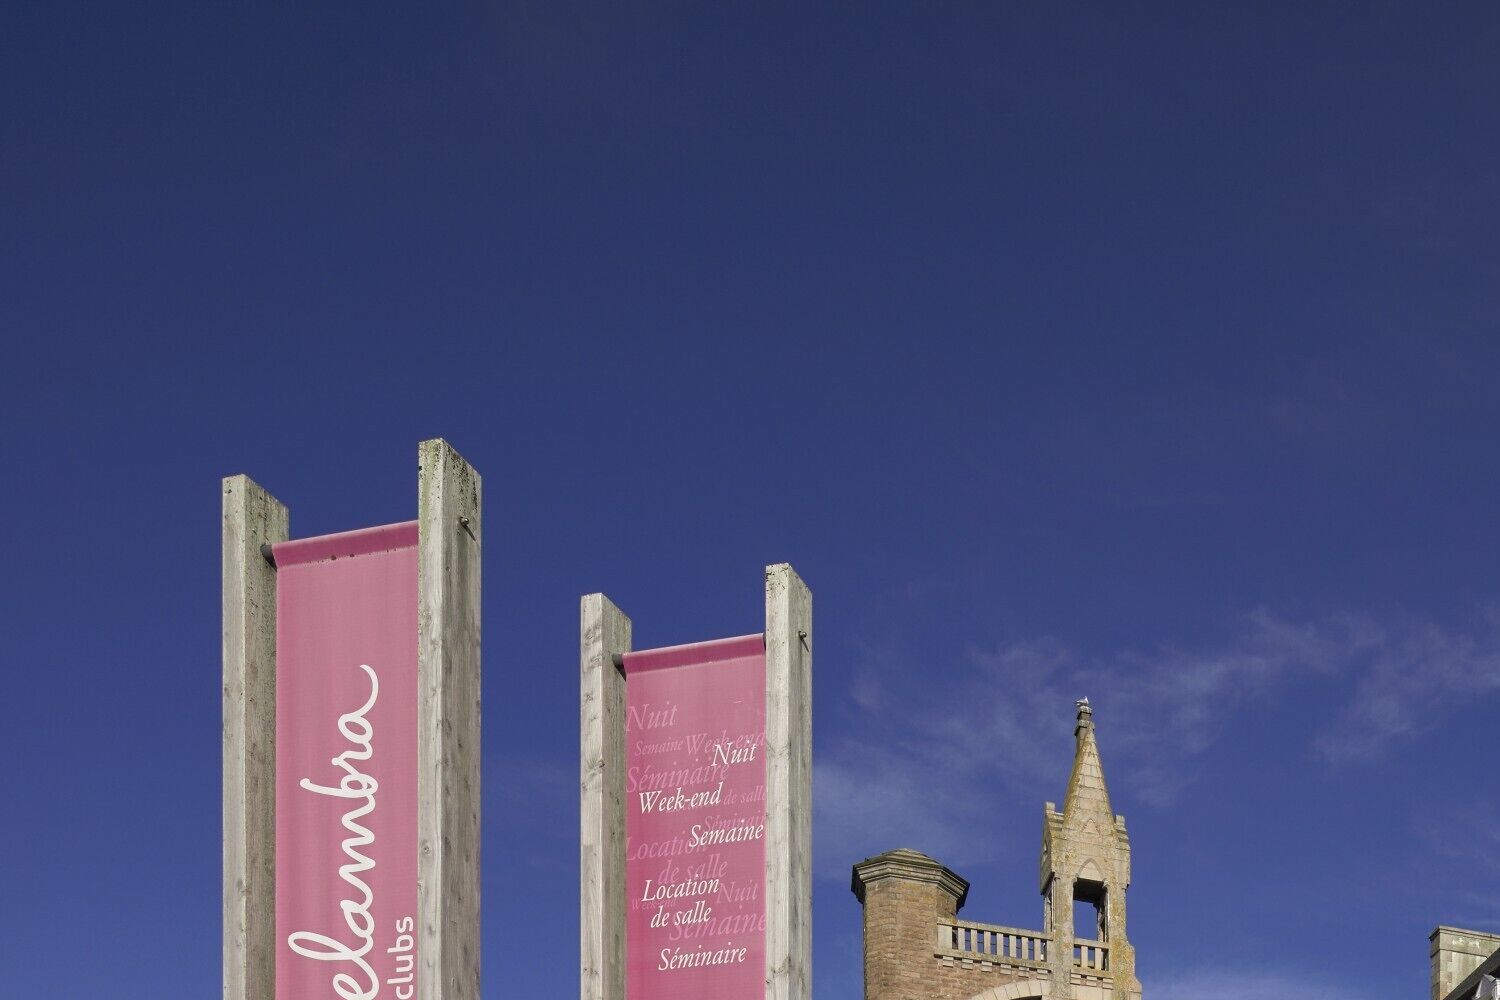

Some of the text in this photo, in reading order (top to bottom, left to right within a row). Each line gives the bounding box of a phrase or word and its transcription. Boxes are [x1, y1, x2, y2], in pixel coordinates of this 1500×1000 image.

[626, 701, 677, 732] Nuit
[711, 740, 757, 767] Nuit
[639, 781, 724, 815] Week-end
[689, 818, 764, 848] Semaine
[641, 873, 720, 902] Location
[717, 880, 758, 904] Nuit
[650, 900, 712, 929] de salle
[386, 916, 414, 1000] clubs
[658, 941, 747, 971] Séminaire
